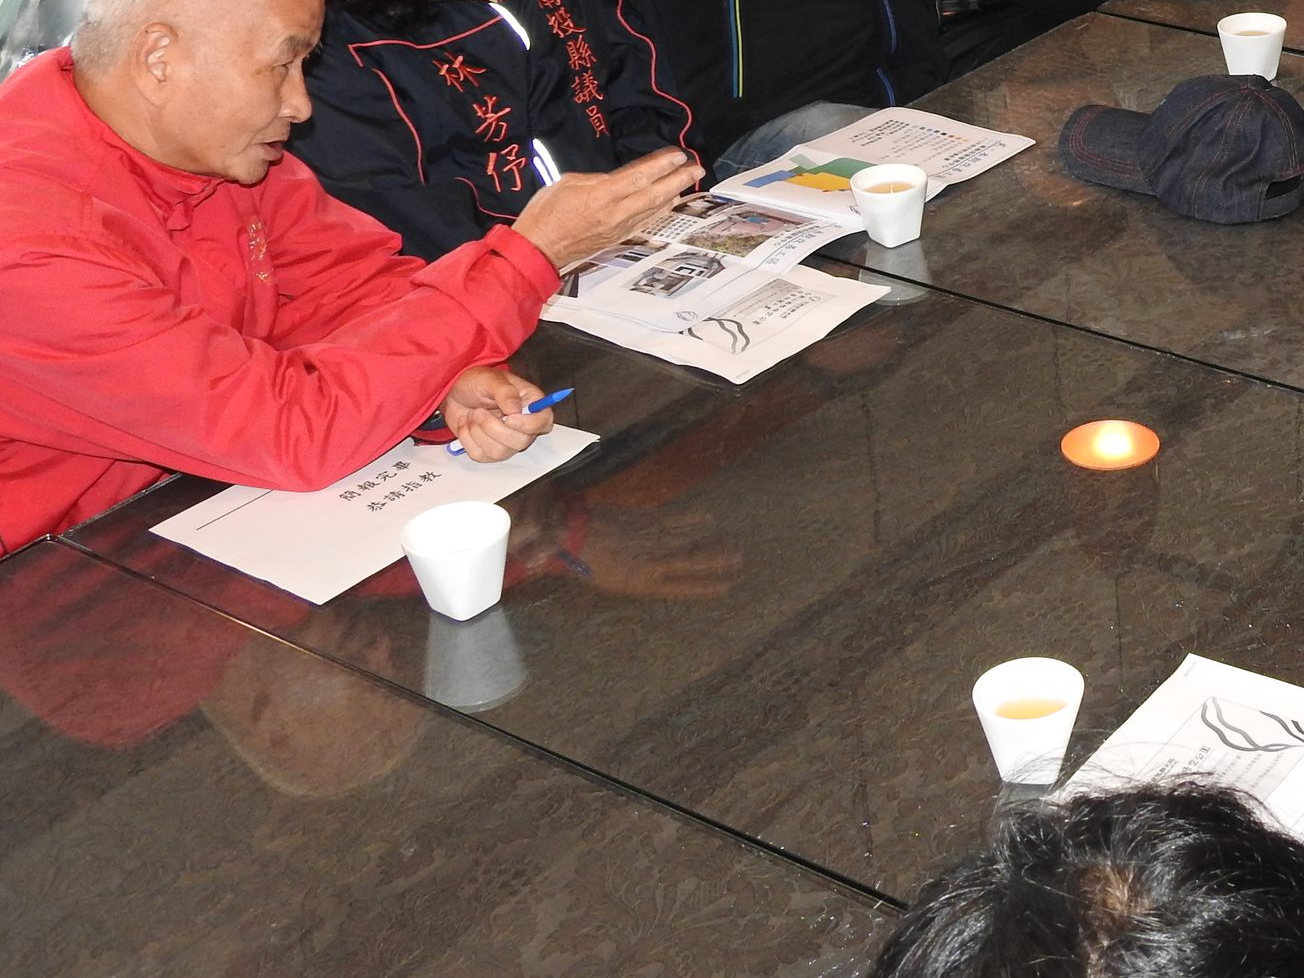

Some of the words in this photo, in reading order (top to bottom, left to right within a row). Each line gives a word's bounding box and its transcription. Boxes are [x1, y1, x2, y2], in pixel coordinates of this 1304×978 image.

[339, 461, 411, 501] 簡報完畢
[367, 472, 443, 512] 恭請指教
